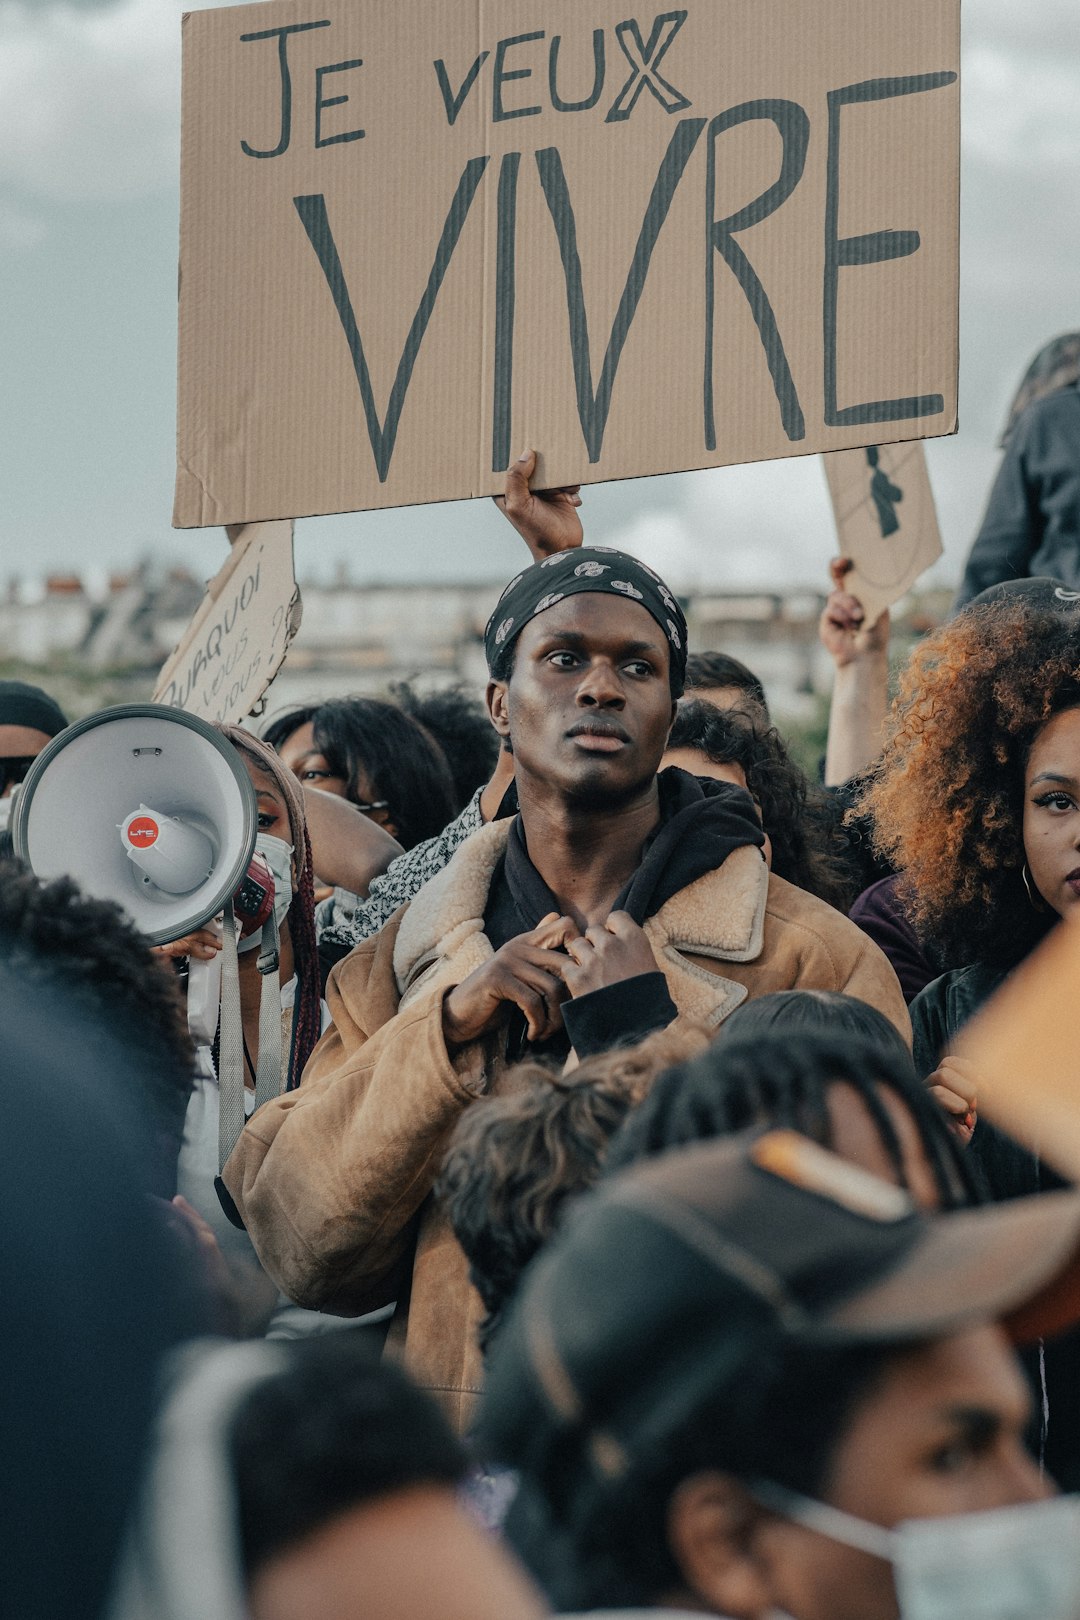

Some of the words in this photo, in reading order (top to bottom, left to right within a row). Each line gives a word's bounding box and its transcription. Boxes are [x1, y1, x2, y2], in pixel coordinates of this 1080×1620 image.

[240, 20, 366, 159] JE
[433, 10, 692, 125] VEUX
[293, 71, 958, 483] VIVRE
